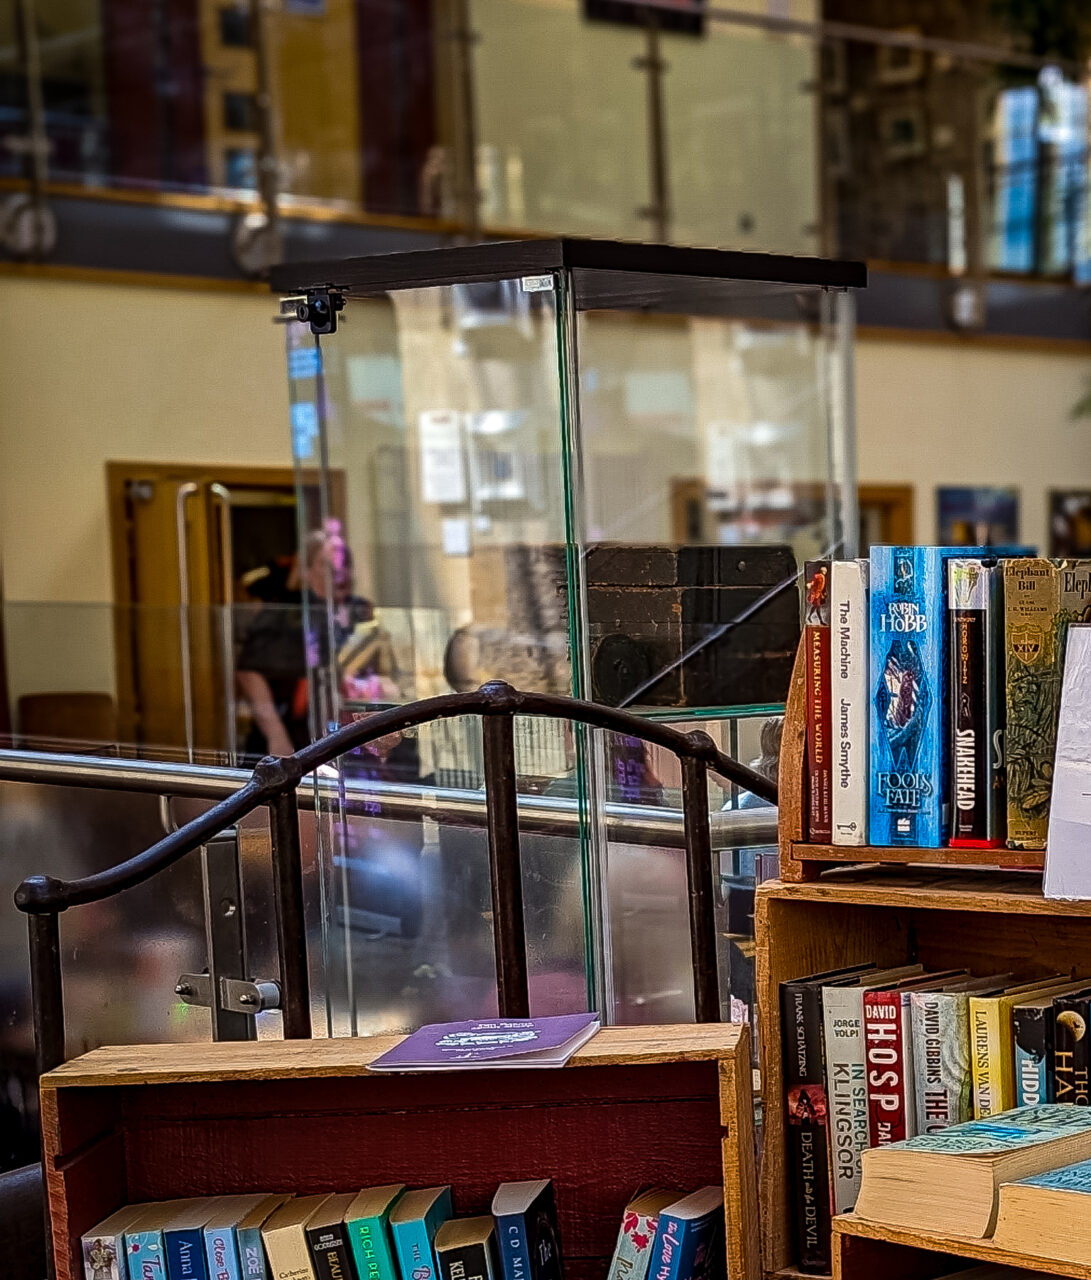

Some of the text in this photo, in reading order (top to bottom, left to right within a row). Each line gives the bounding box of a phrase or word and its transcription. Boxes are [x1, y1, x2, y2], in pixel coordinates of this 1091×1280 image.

[840, 601, 849, 679] The Machine
[880, 613, 927, 632] HOBB
[888, 603, 919, 616] ROBIN
[839, 699, 851, 788] James Smythe
[956, 729, 975, 811] SNAKEHEAD
[866, 1005, 896, 1019] DAVID
[867, 1023, 899, 1111] HOSP
